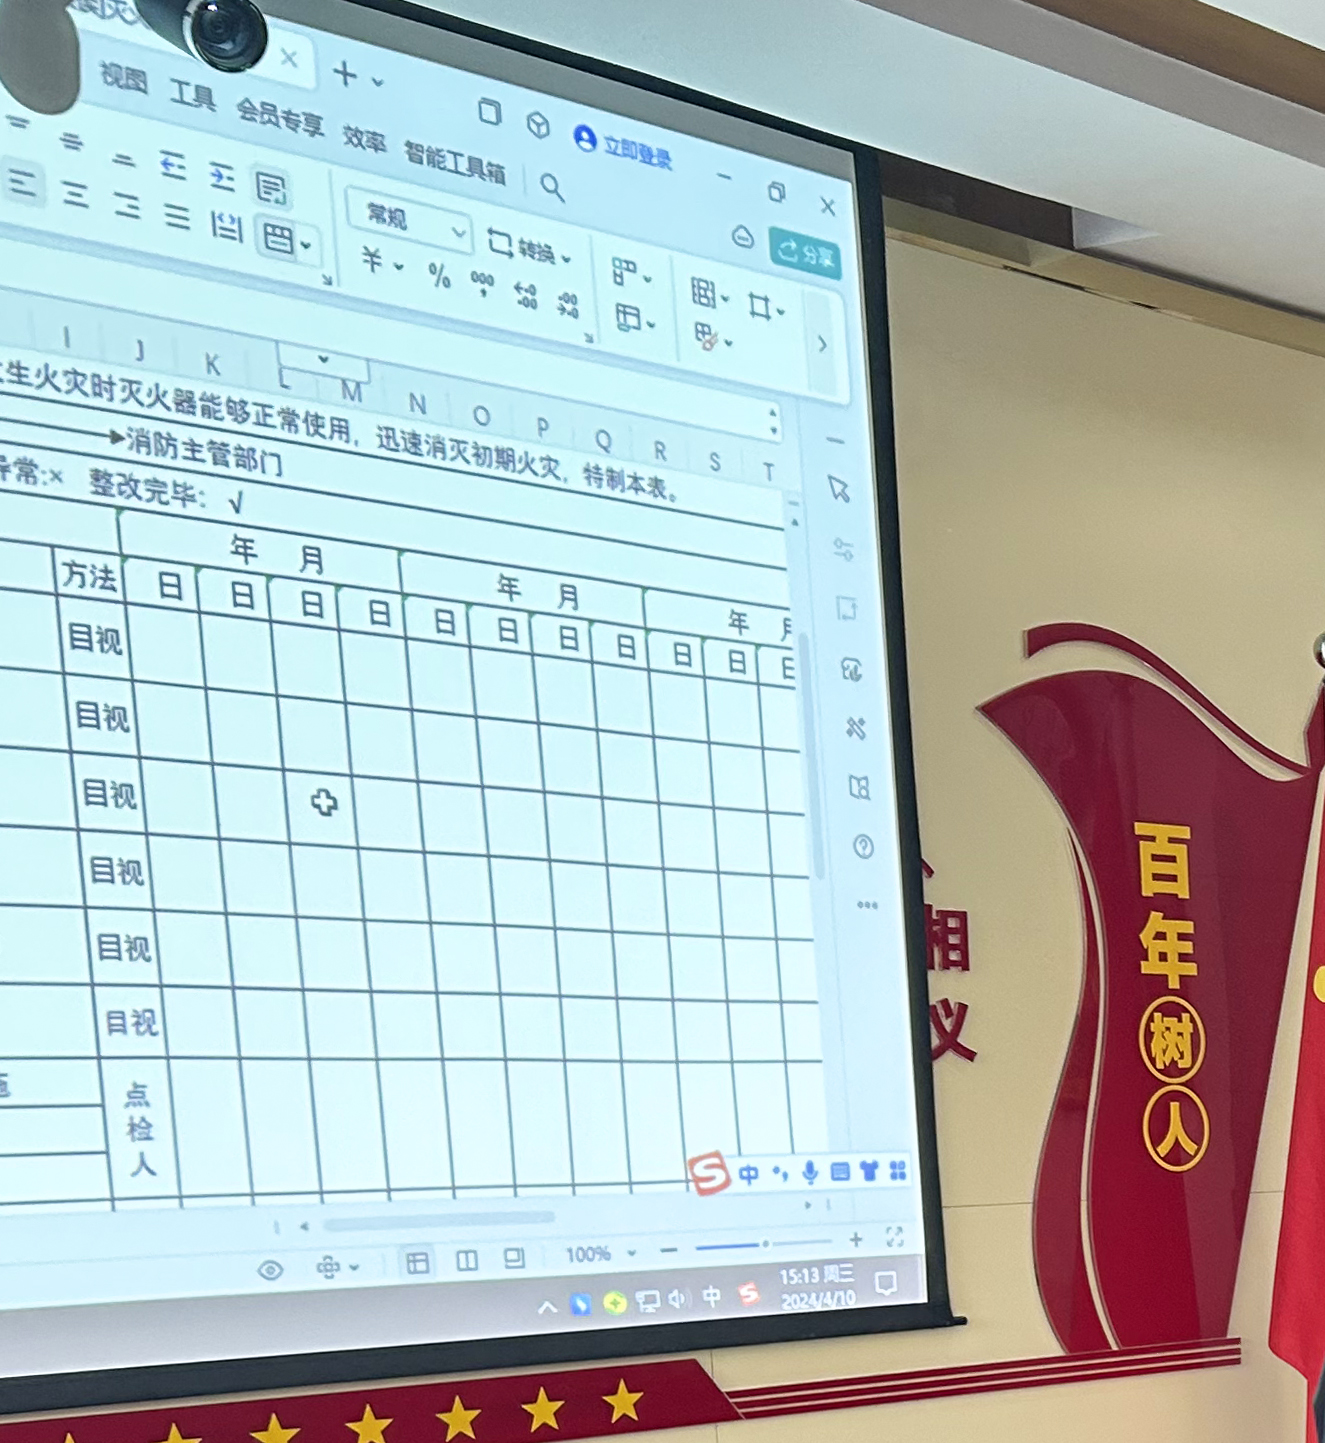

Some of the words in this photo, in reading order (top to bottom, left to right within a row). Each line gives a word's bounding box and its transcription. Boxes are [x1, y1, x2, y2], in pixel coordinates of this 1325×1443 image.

[99, 60, 149, 95] 视图
[169, 78, 217, 113] 工具
[236, 97, 325, 138] 会员专享
[343, 125, 388, 154] 效率
[404, 140, 507, 187] 智能工具箱
[603, 135, 674, 172] 立即登录
[368, 202, 408, 231] 常规
[205, 354, 221, 376] K
[342, 380, 362, 403] M
[409, 394, 426, 415] N
[473, 406, 491, 427] O
[537, 418, 549, 437] P
[595, 429, 612, 452] Q
[655, 442, 667, 461] R
[709, 453, 721, 472] S
[763, 463, 775, 481] T
[127, 427, 282, 477] 消防主管部门
[230, 534, 258, 565] 年
[300, 546, 324, 574] 月
[62, 561, 117, 592] 方法
[497, 574, 522, 602] 年
[558, 584, 579, 610] 月
[160, 572, 182, 600] 日
[232, 582, 254, 609] 日
[303, 591, 324, 618] 日
[370, 600, 390, 626] 日
[435, 608, 455, 635] 日
[499, 617, 518, 643] 日
[560, 625, 578, 651] 日
[618, 633, 635, 659] 日
[674, 642, 691, 667] 日
[729, 649, 746, 673] 日
[728, 610, 750, 635] 年
[69, 623, 123, 656] 目视
[76, 700, 130, 732] 目视
[83, 778, 137, 810] 目视
[90, 856, 144, 887] 目视
[97, 934, 151, 963] 目视
[1134, 822, 1208, 1169] 百年树人
[106, 1009, 159, 1037] 目视
[124, 1081, 157, 1178] 点检人
[738, 1164, 759, 1185] 中
[567, 1246, 611, 1264] 100%
[779, 1265, 821, 1286] 15:13
[823, 1263, 855, 1283] 周三
[702, 1285, 721, 1308] 中
[780, 1289, 857, 1311] 2024/4/10
